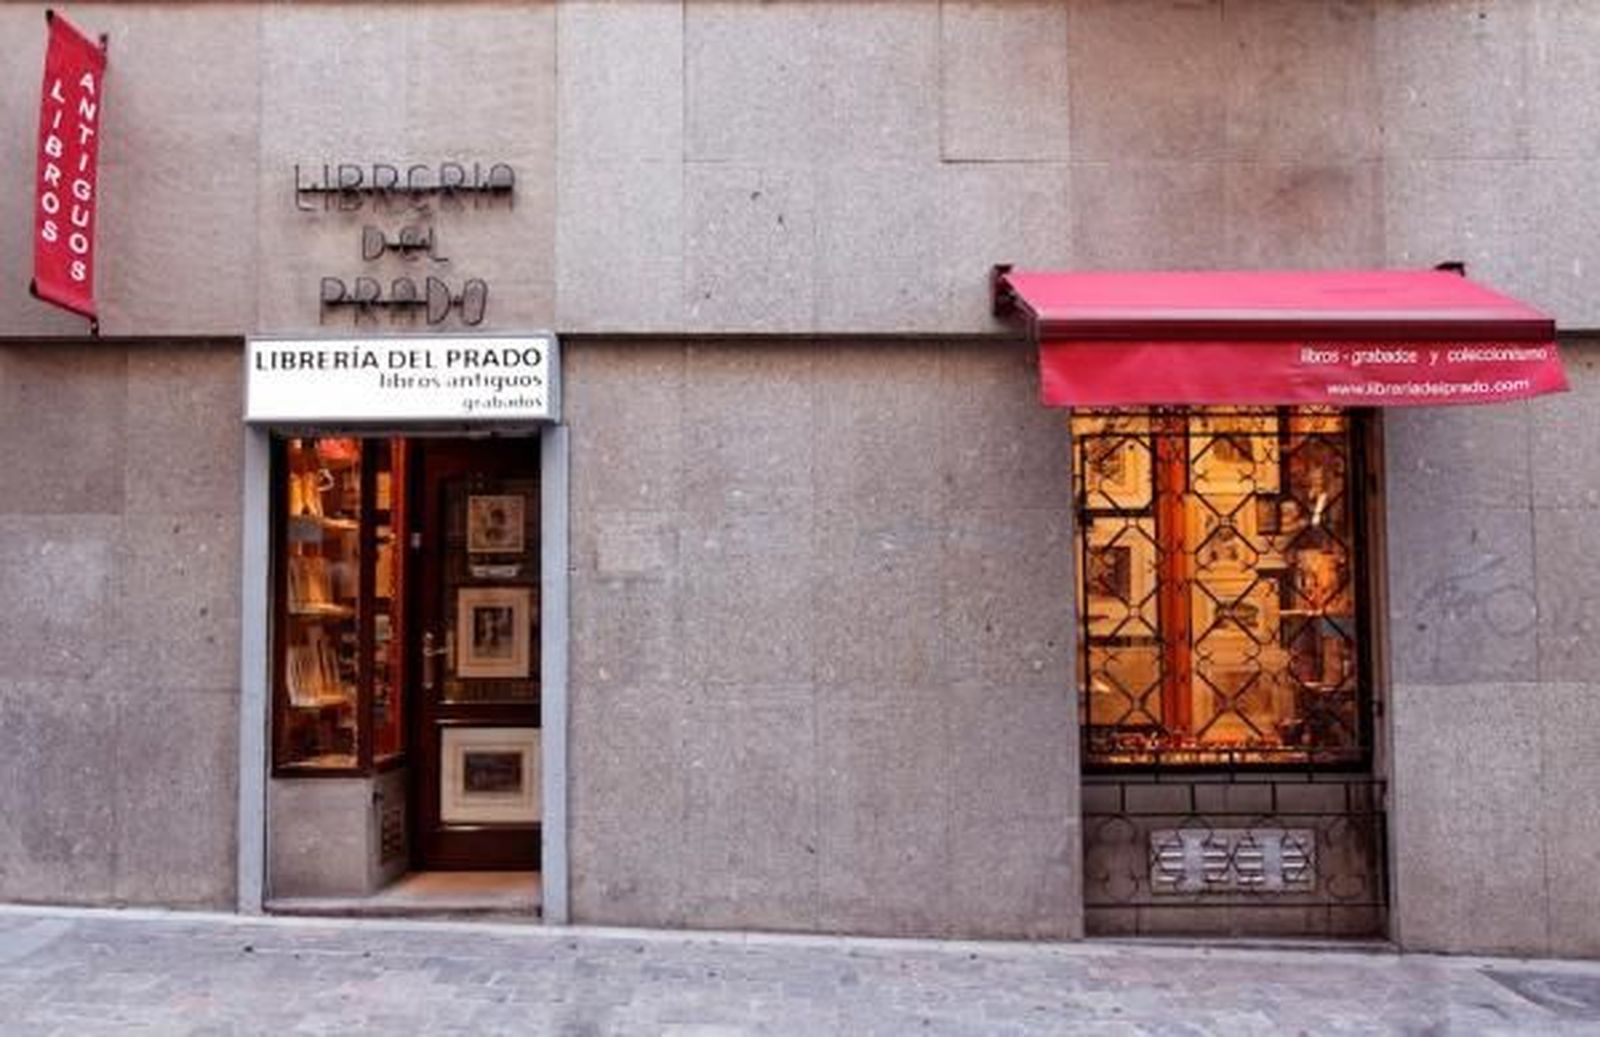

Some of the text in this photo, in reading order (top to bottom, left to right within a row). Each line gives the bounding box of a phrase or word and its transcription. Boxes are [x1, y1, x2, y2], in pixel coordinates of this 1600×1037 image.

[41, 79, 66, 243] LIBROS
[69, 72, 97, 281] ANTIGUOS
[320, 276, 488, 327] PRADO
[256, 346, 543, 370] LIBRERÍA DEL PRADO
[1429, 351, 1439, 366] y
[379, 372, 543, 391] libros antiguos
[462, 394, 543, 410] grabados
